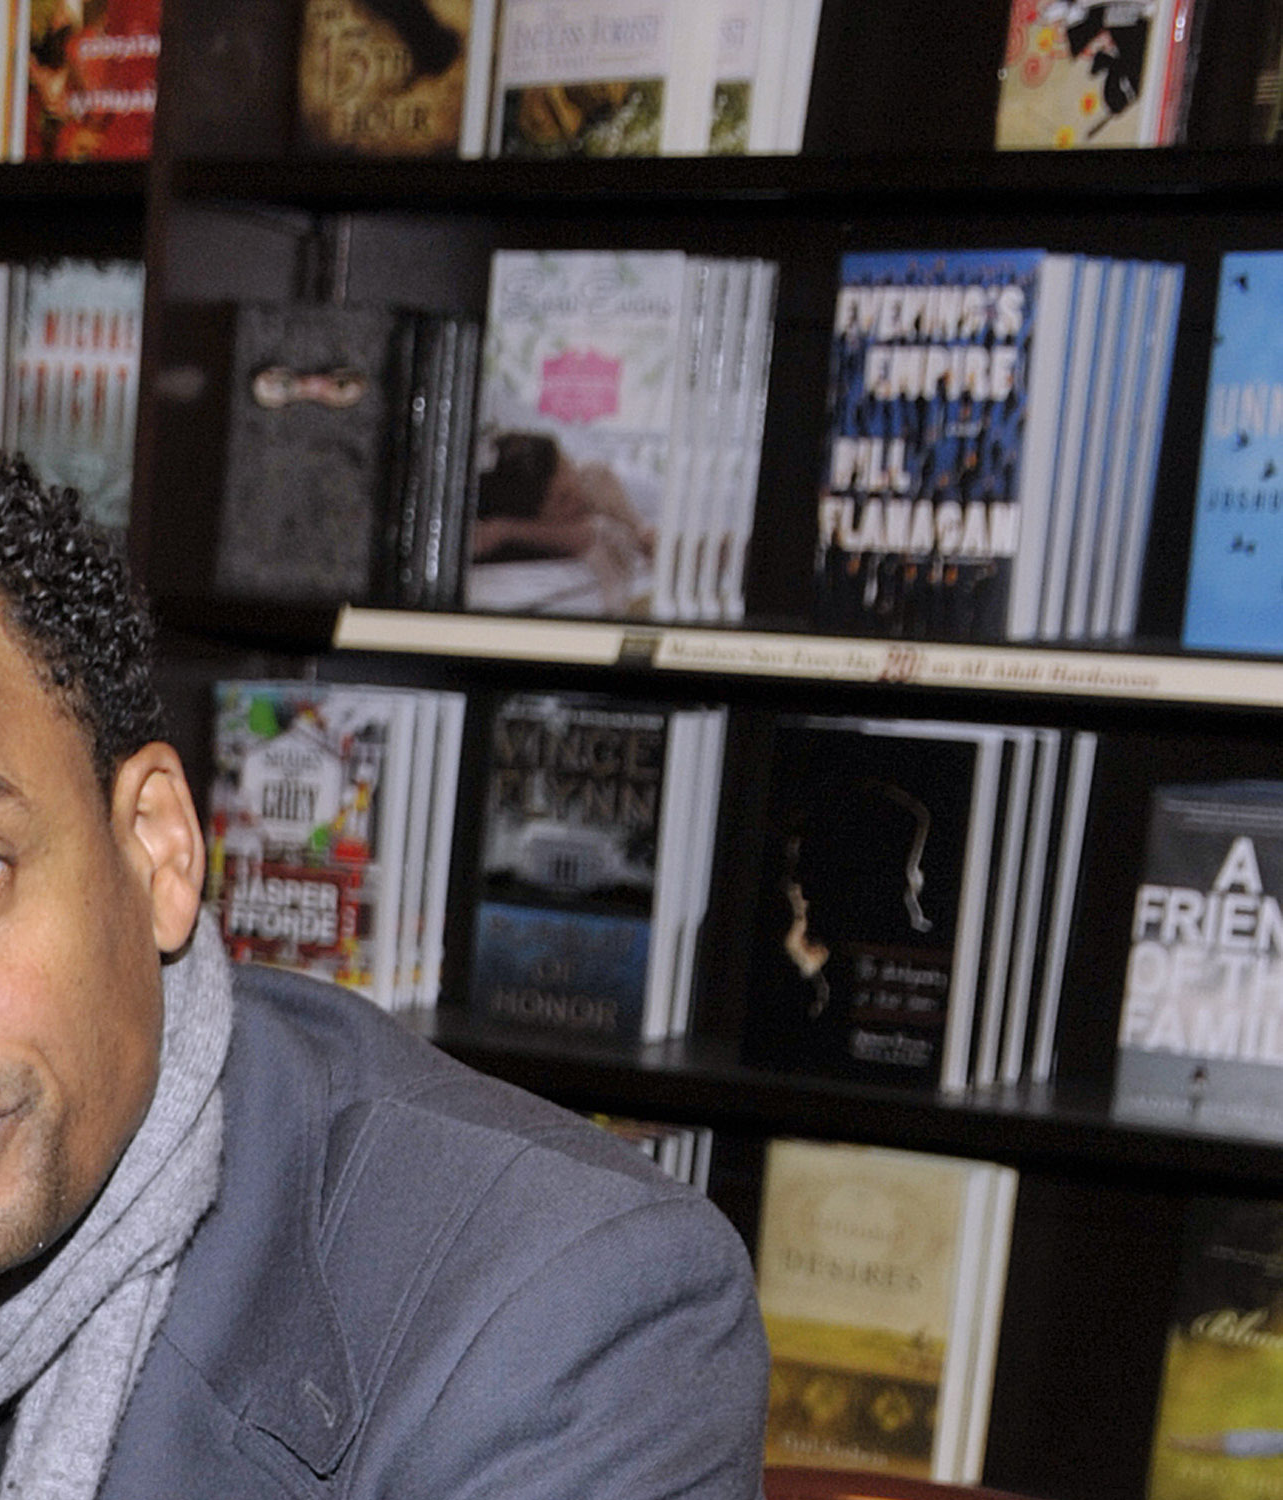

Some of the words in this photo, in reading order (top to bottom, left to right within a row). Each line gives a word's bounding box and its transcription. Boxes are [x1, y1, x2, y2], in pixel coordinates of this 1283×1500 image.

[864, 344, 1018, 400] EMPIRE
[819, 499, 1018, 558] FLANAGAN
[1212, 835, 1263, 893] A
[1127, 941, 1208, 996] OF
